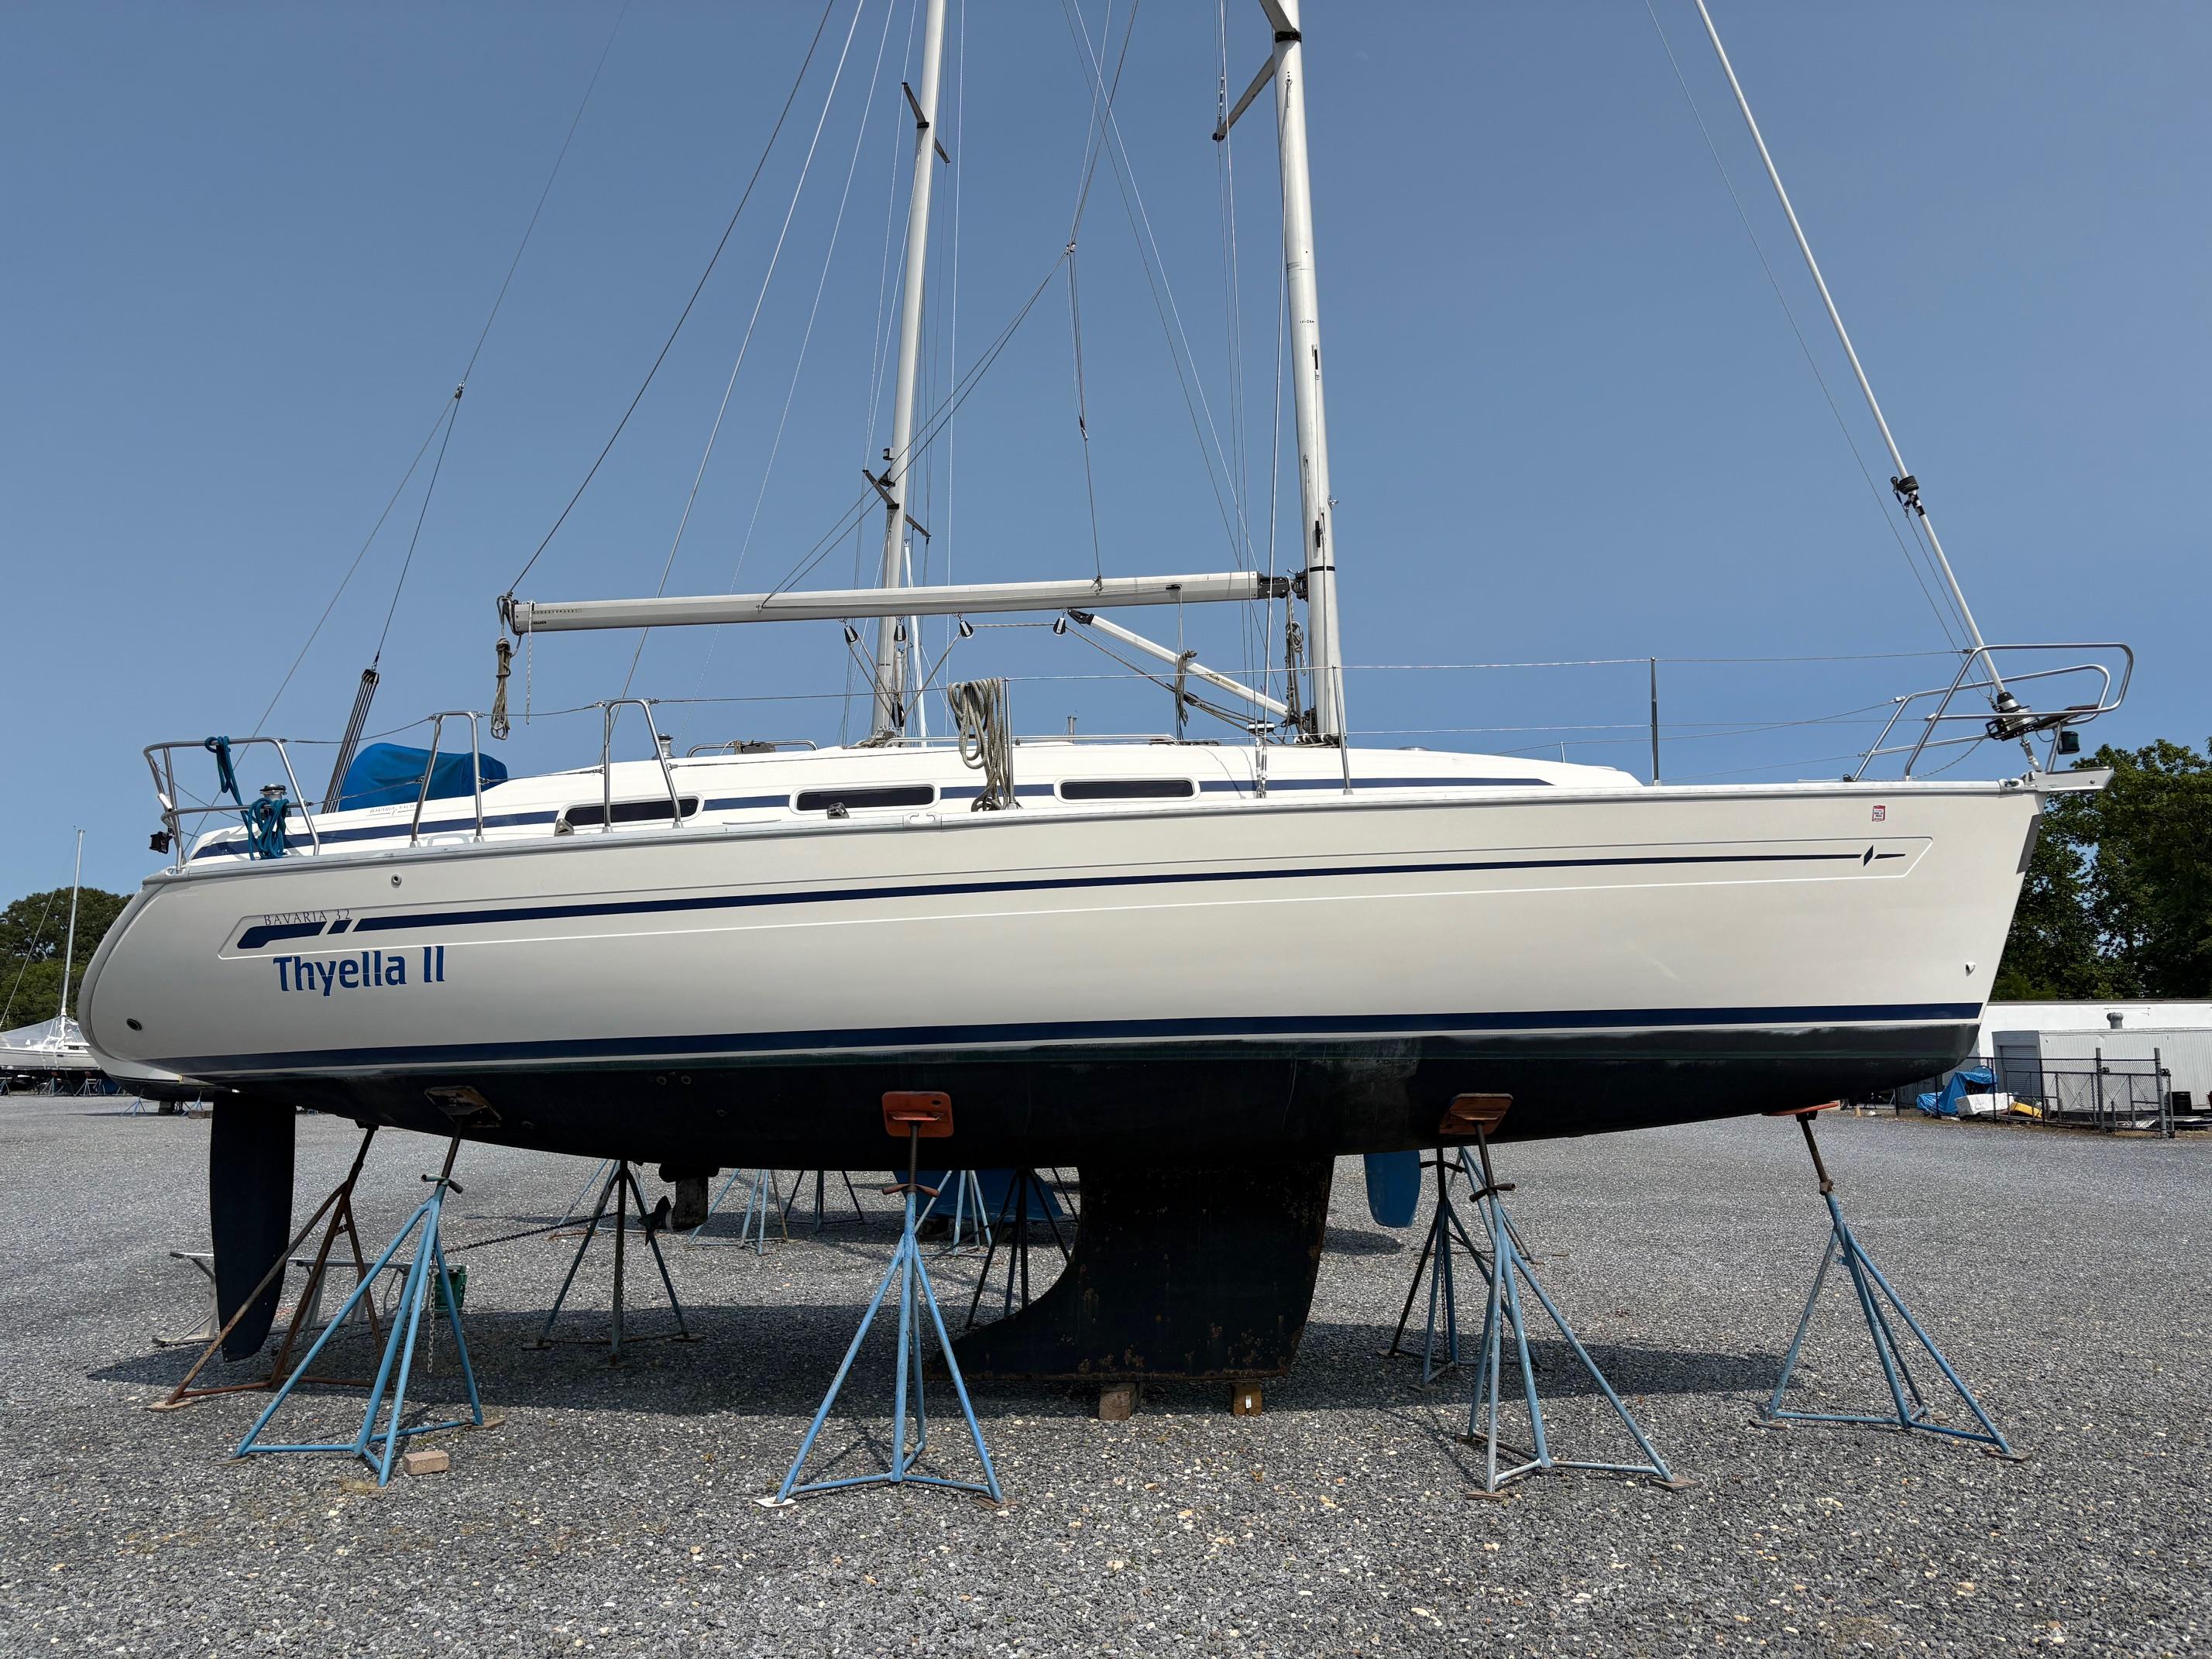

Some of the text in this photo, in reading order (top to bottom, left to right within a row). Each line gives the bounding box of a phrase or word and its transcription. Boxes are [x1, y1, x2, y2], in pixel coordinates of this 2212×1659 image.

[264, 908, 351, 925] BAVARIA 32
[273, 945, 446, 997] Thyella II
